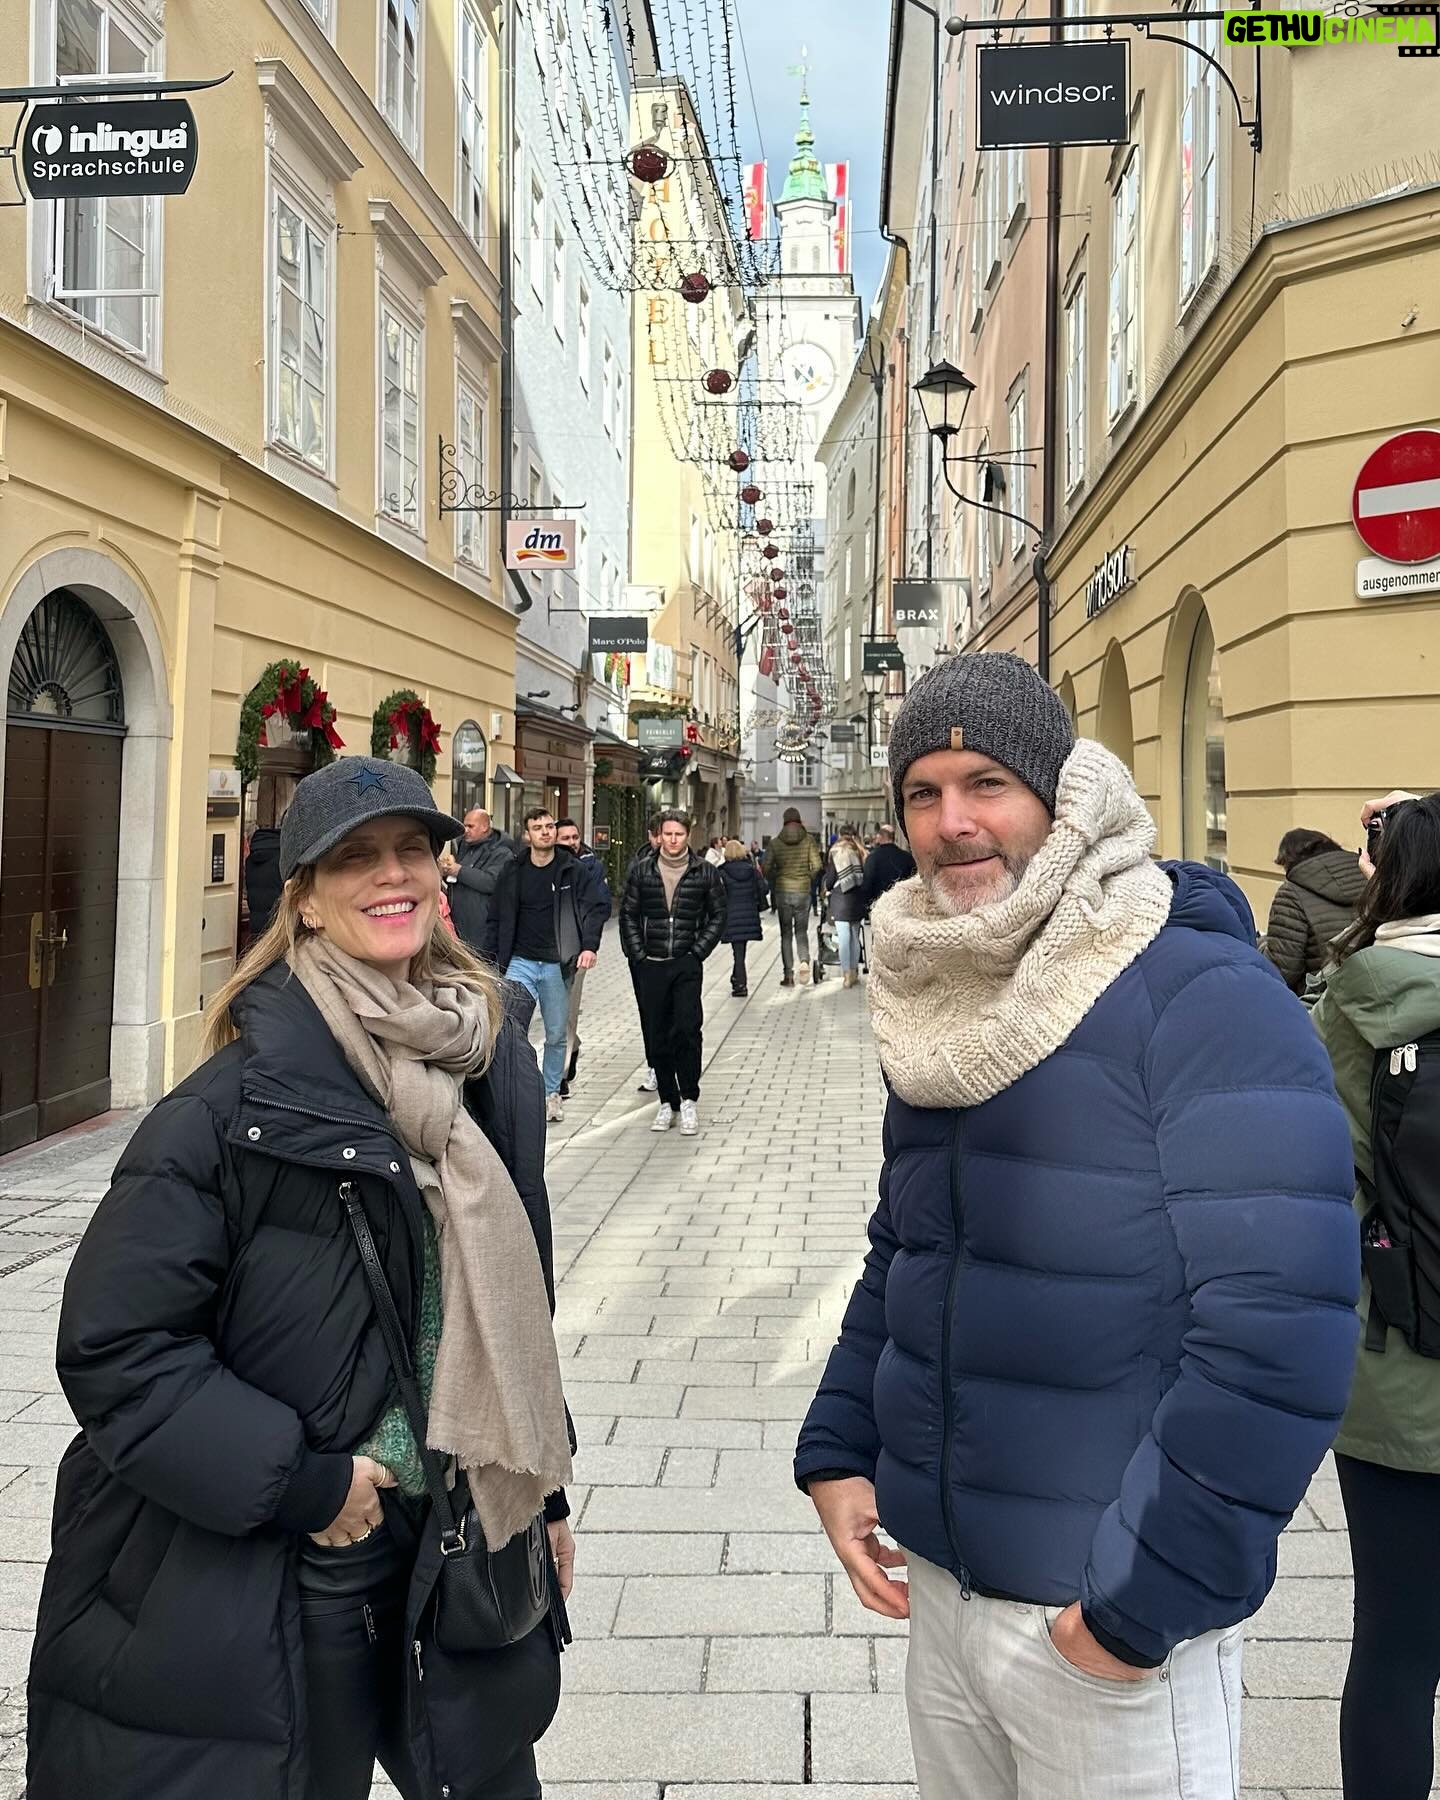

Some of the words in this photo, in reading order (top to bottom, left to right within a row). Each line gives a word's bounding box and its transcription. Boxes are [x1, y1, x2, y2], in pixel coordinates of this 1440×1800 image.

[990, 82, 1116, 106] windsor.
[69, 122, 188, 158] inlingua
[32, 156, 185, 181] Sprachschule
[525, 528, 561, 549] dm
[895, 608, 939, 621] BRAX
[592, 637, 616, 646] Marc
[616, 637, 646, 646] O'Polo
